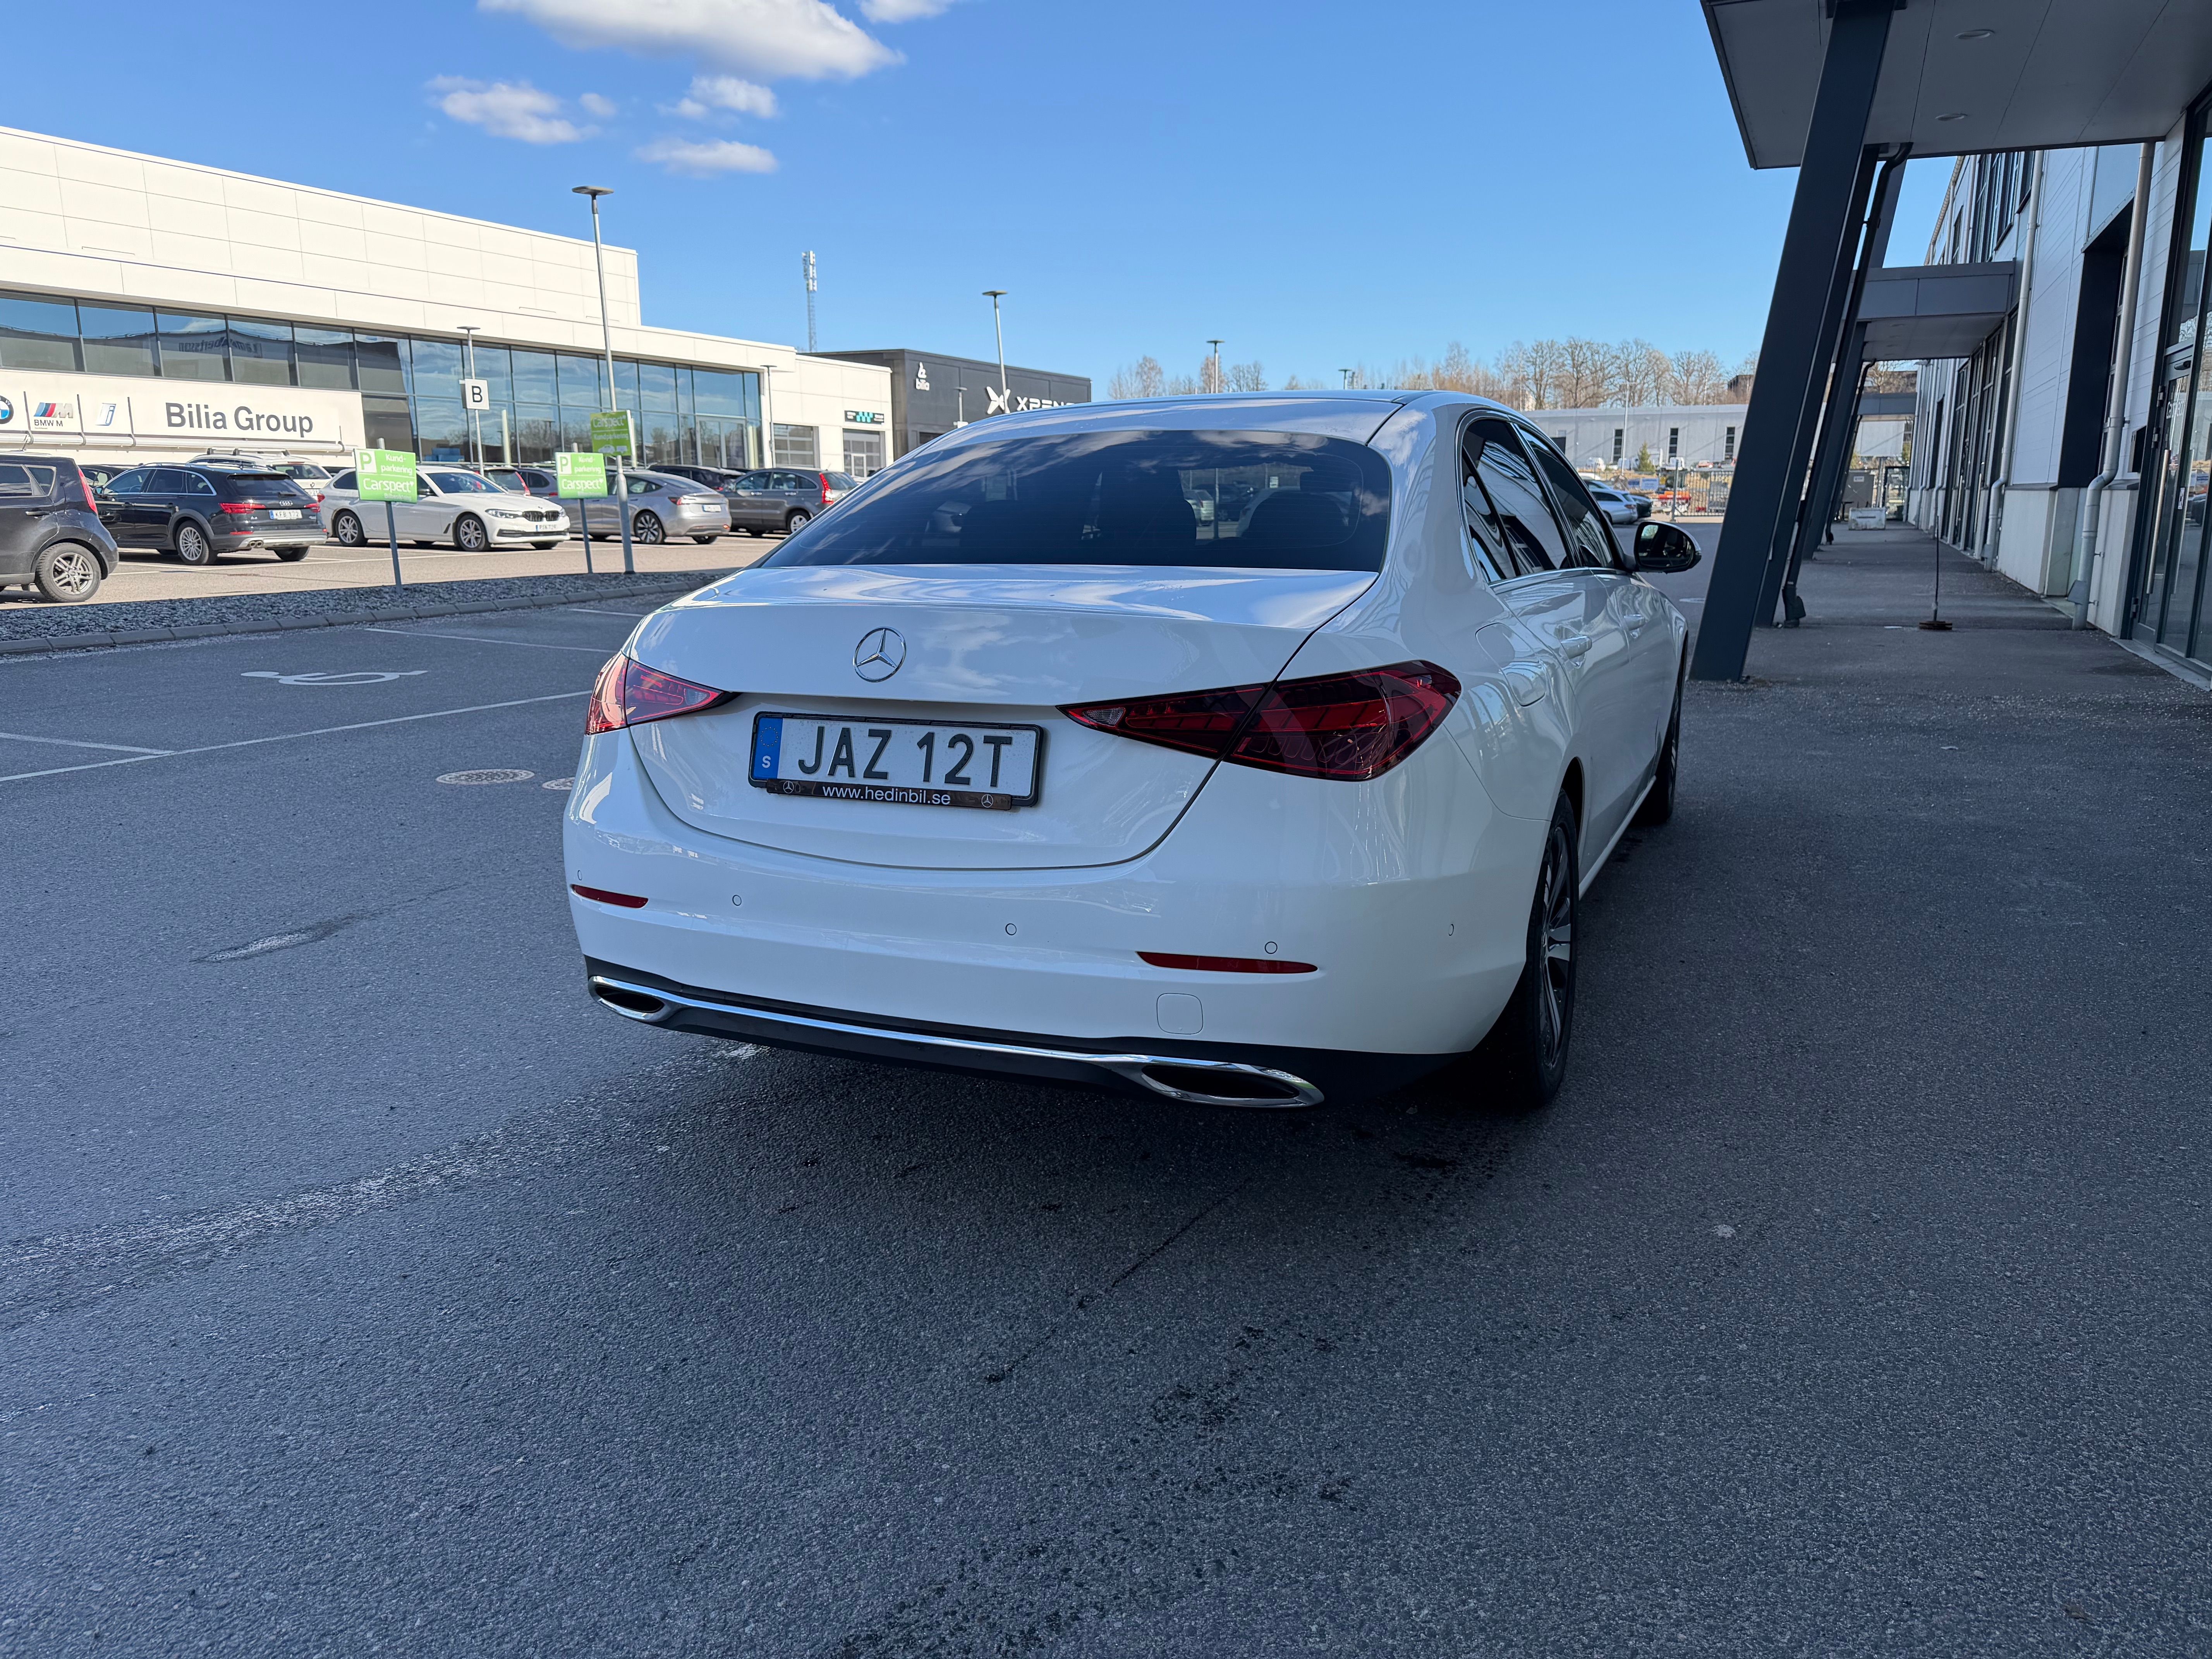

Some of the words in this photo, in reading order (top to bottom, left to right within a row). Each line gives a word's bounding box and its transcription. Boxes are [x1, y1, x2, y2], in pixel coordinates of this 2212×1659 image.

[471, 385, 483, 403] B
[1017, 396, 1075, 411] XPE
[166, 403, 228, 429] Bilia
[234, 406, 313, 438] Group
[593, 417, 624, 428] Carspect
[360, 452, 372, 470] P
[385, 453, 406, 462] Kund-
[560, 456, 568, 472] P
[381, 464, 413, 476] parkering
[574, 465, 602, 474] parkering
[363, 478, 411, 493] Carspect
[562, 478, 601, 491] Carspect
[762, 756, 771, 769] S
[798, 726, 892, 780] JAZ
[917, 732, 1013, 788] 12T
[822, 786, 951, 805] www.hedinbil.se
